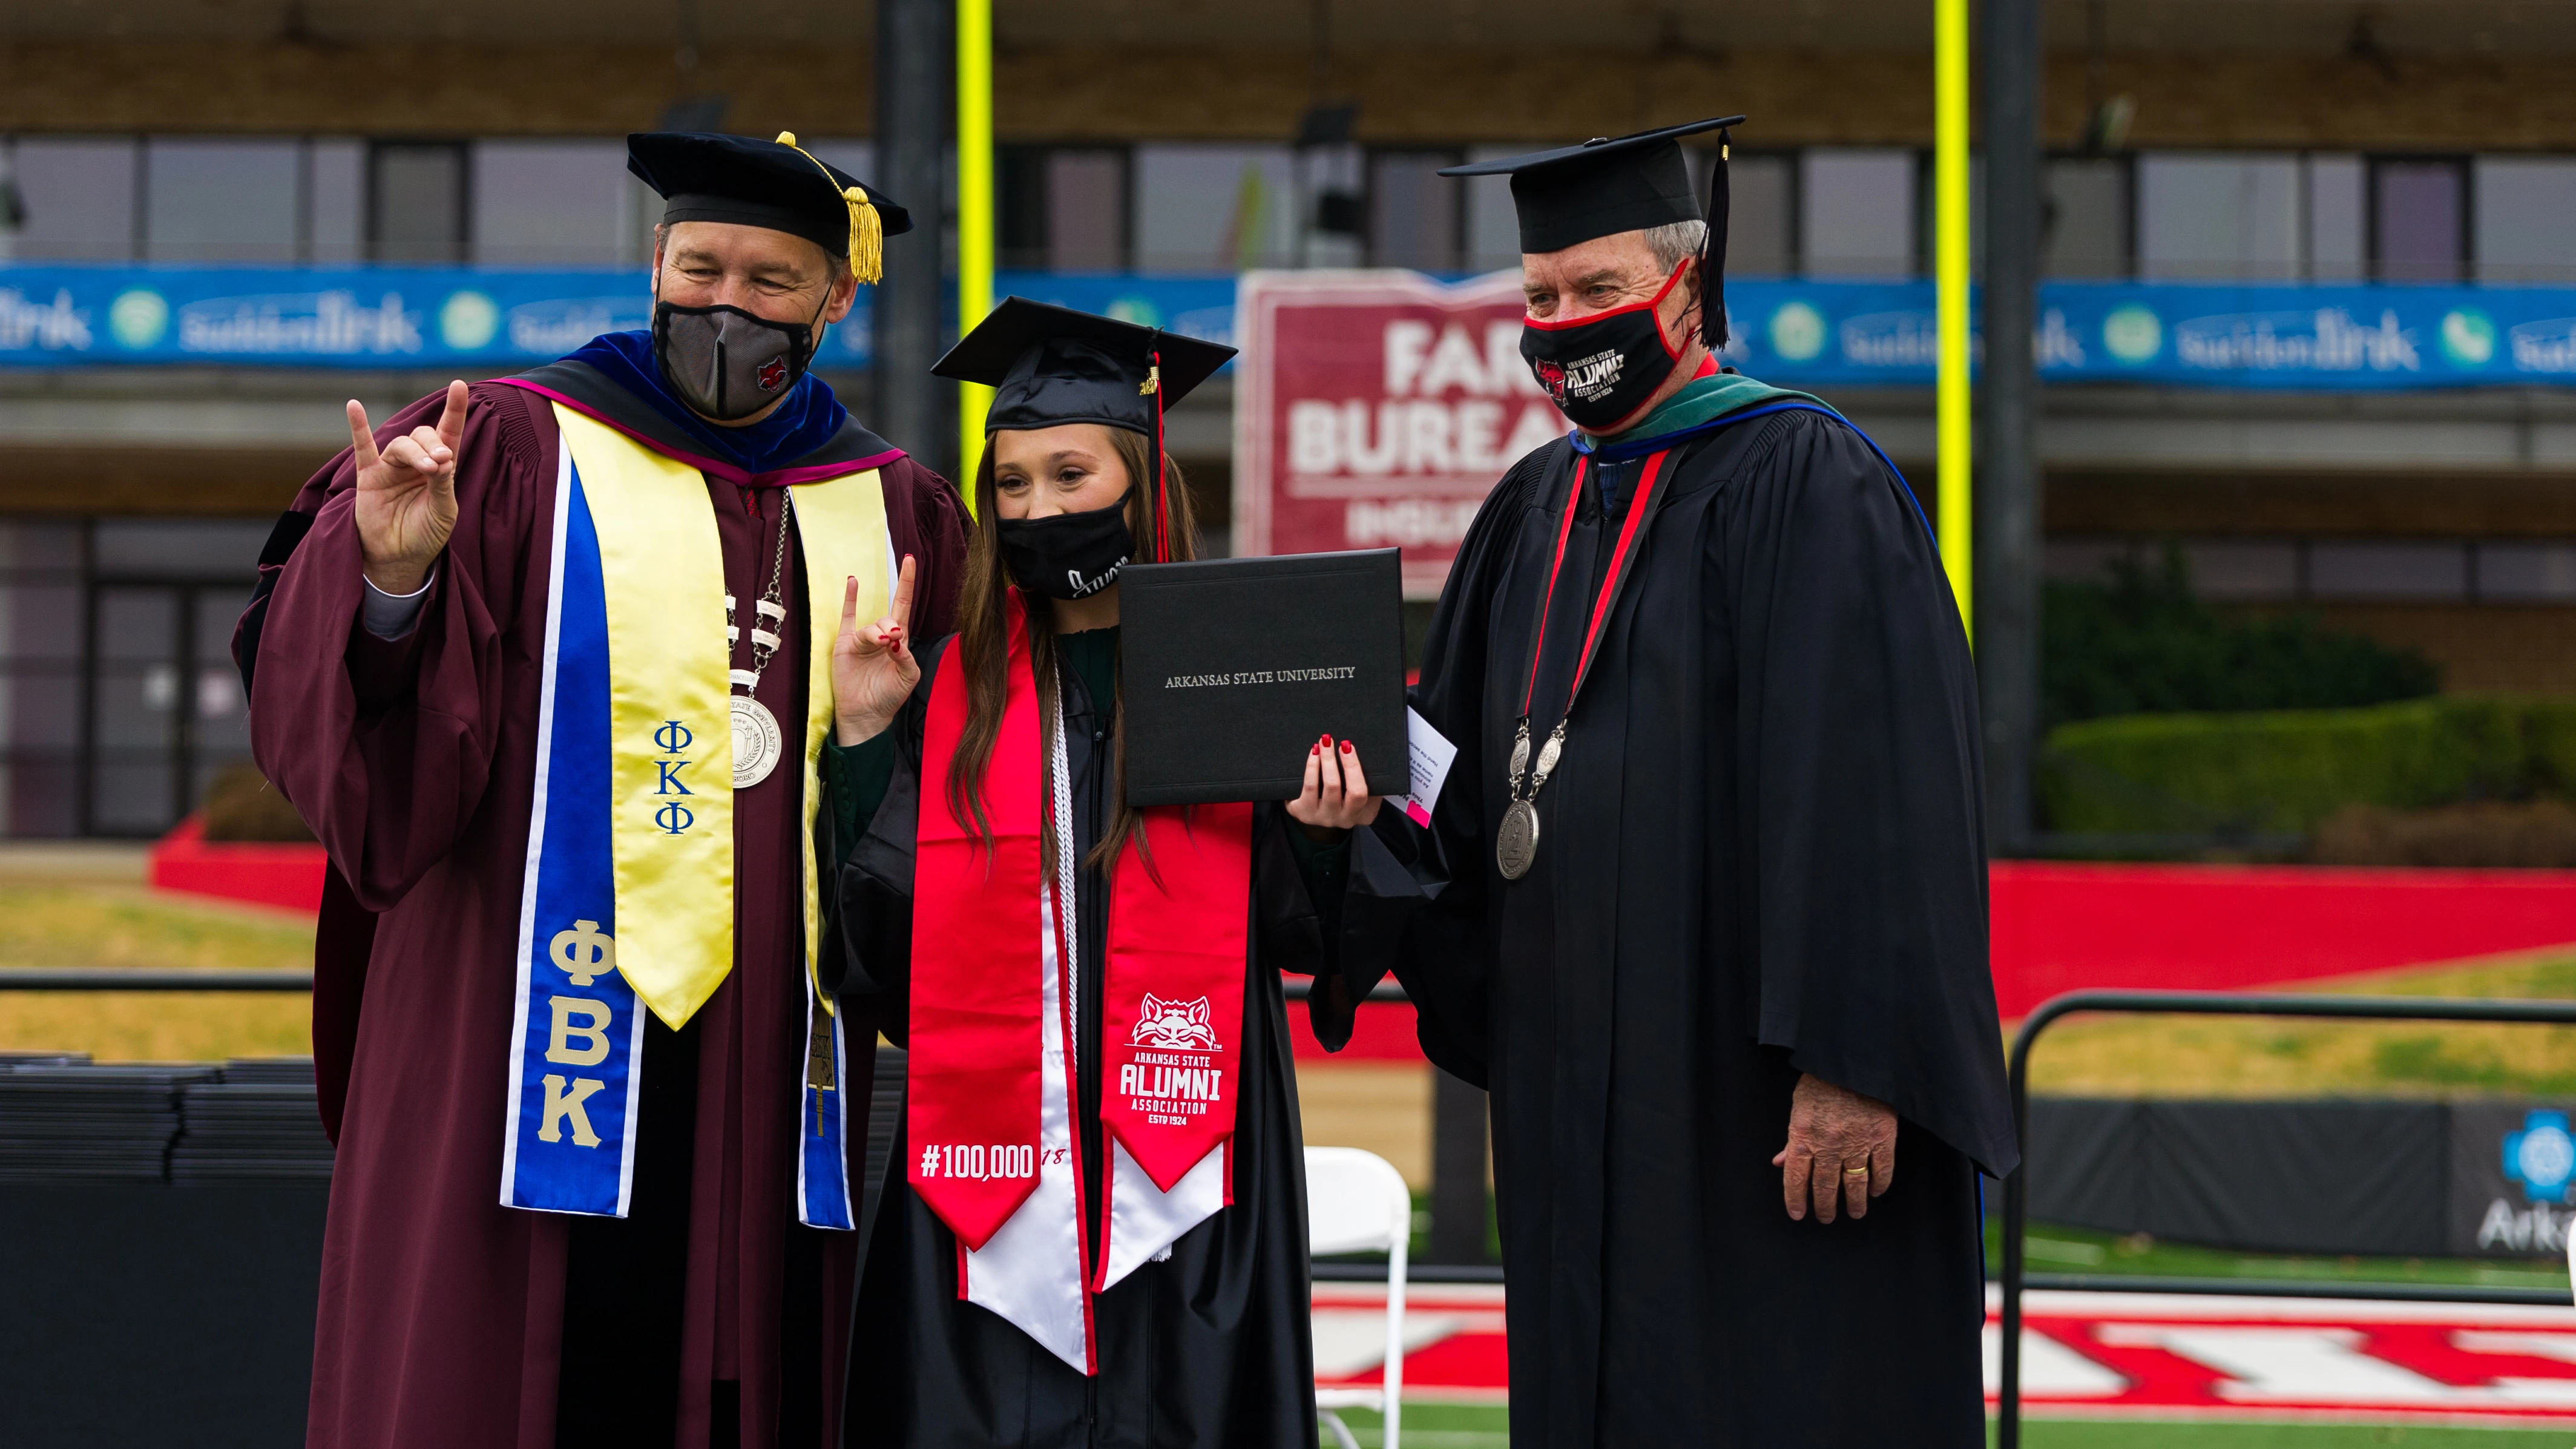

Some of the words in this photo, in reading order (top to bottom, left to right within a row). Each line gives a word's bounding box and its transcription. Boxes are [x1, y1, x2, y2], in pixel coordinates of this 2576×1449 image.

[1386, 321, 1540, 394] FAR
[1565, 354, 1624, 389] ALUMNI
[1567, 355, 1597, 370] ARKANSAS
[1597, 349, 1615, 361] STATE
[1574, 372, 1620, 398] ASSOCIATION
[1290, 401, 1569, 473] BUREA
[1344, 501, 1477, 546] INSU
[1165, 674, 1230, 688] ARKANSAS
[1234, 671, 1273, 685] STATE
[1277, 666, 1355, 682] UNIVERSITY
[731, 702, 751, 711] TATE
[753, 708, 776, 754] UNIVERSITY
[1134, 1051, 1179, 1066] ARKANSAS
[1182, 1055, 1211, 1068] STATE
[1120, 1063, 1222, 1101] ALUMNI
[1131, 1098, 1207, 1114] ASSOCIATION
[1169, 1116, 1187, 1126] 1924
[921, 1144, 1033, 1182] #100,000
[1042, 1148, 1066, 1166] 18
